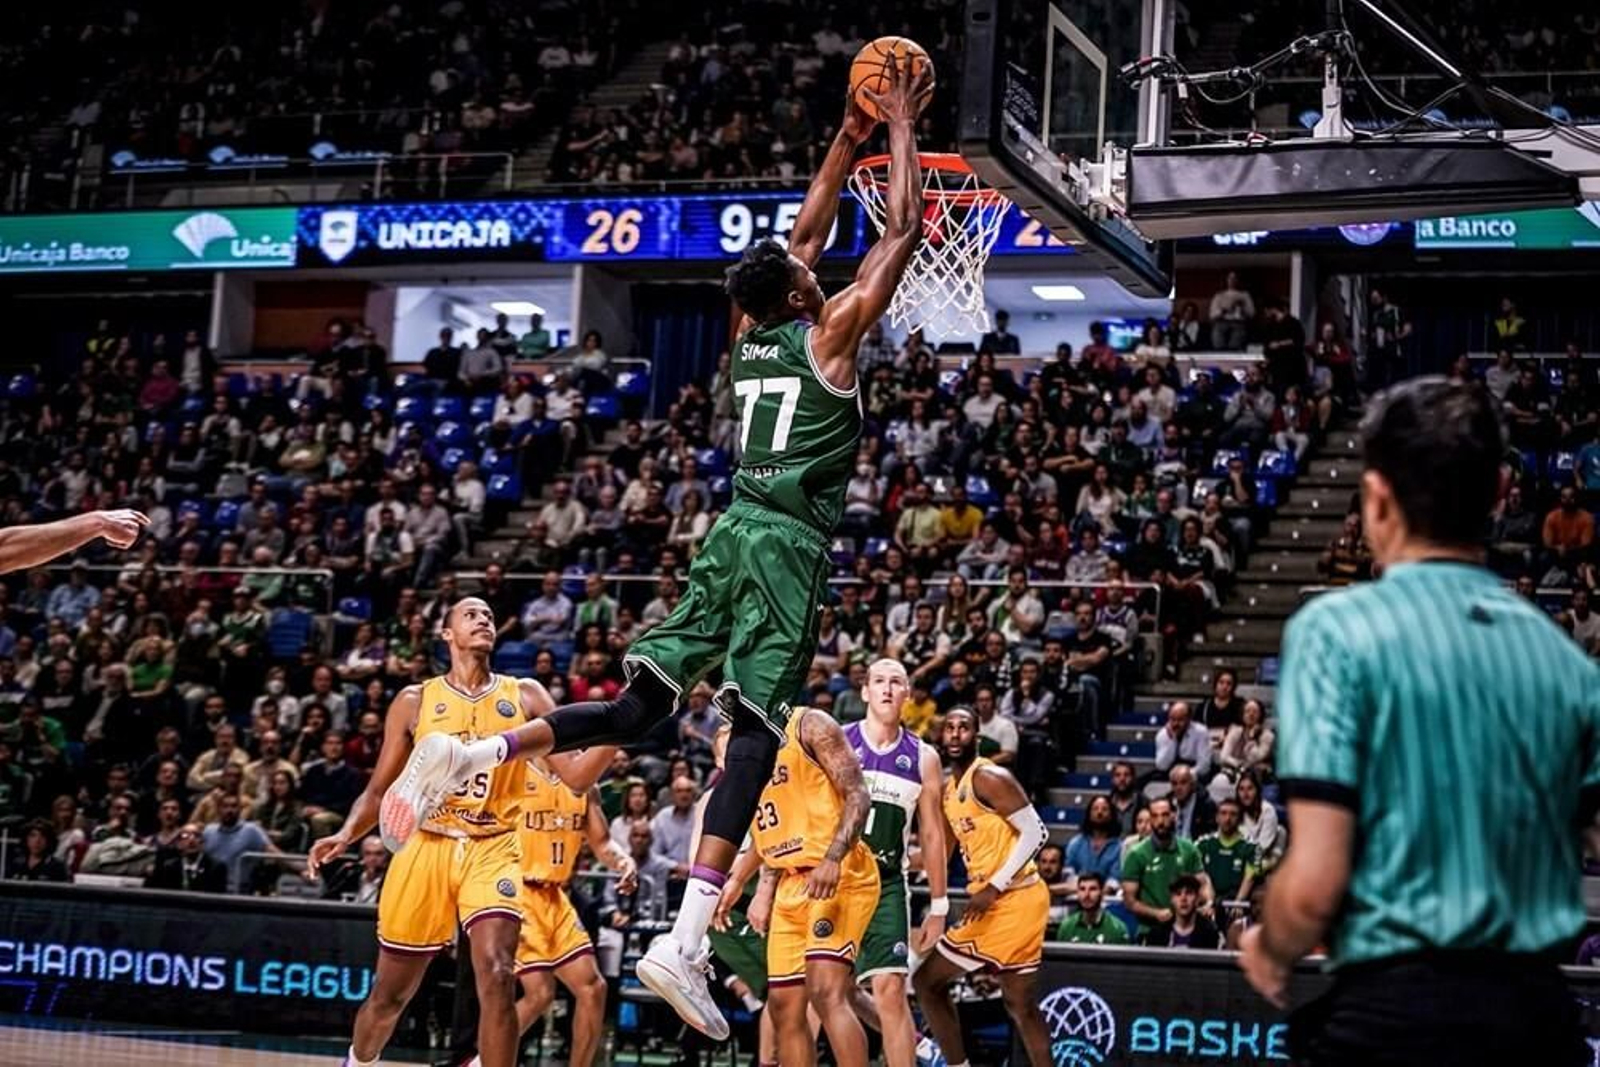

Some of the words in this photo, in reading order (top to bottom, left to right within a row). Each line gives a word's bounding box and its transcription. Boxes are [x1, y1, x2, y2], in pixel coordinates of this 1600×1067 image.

[378, 219, 511, 249] UNICAJA
[580, 209, 643, 254] 26
[1439, 217, 1517, 238] Banco
[69, 242, 130, 261] Banco
[741, 343, 780, 360] SIMA
[734, 376, 801, 452] 77
[756, 802, 779, 831] 23
[552, 842, 564, 864] 11
[234, 960, 376, 1000] LEAGU
